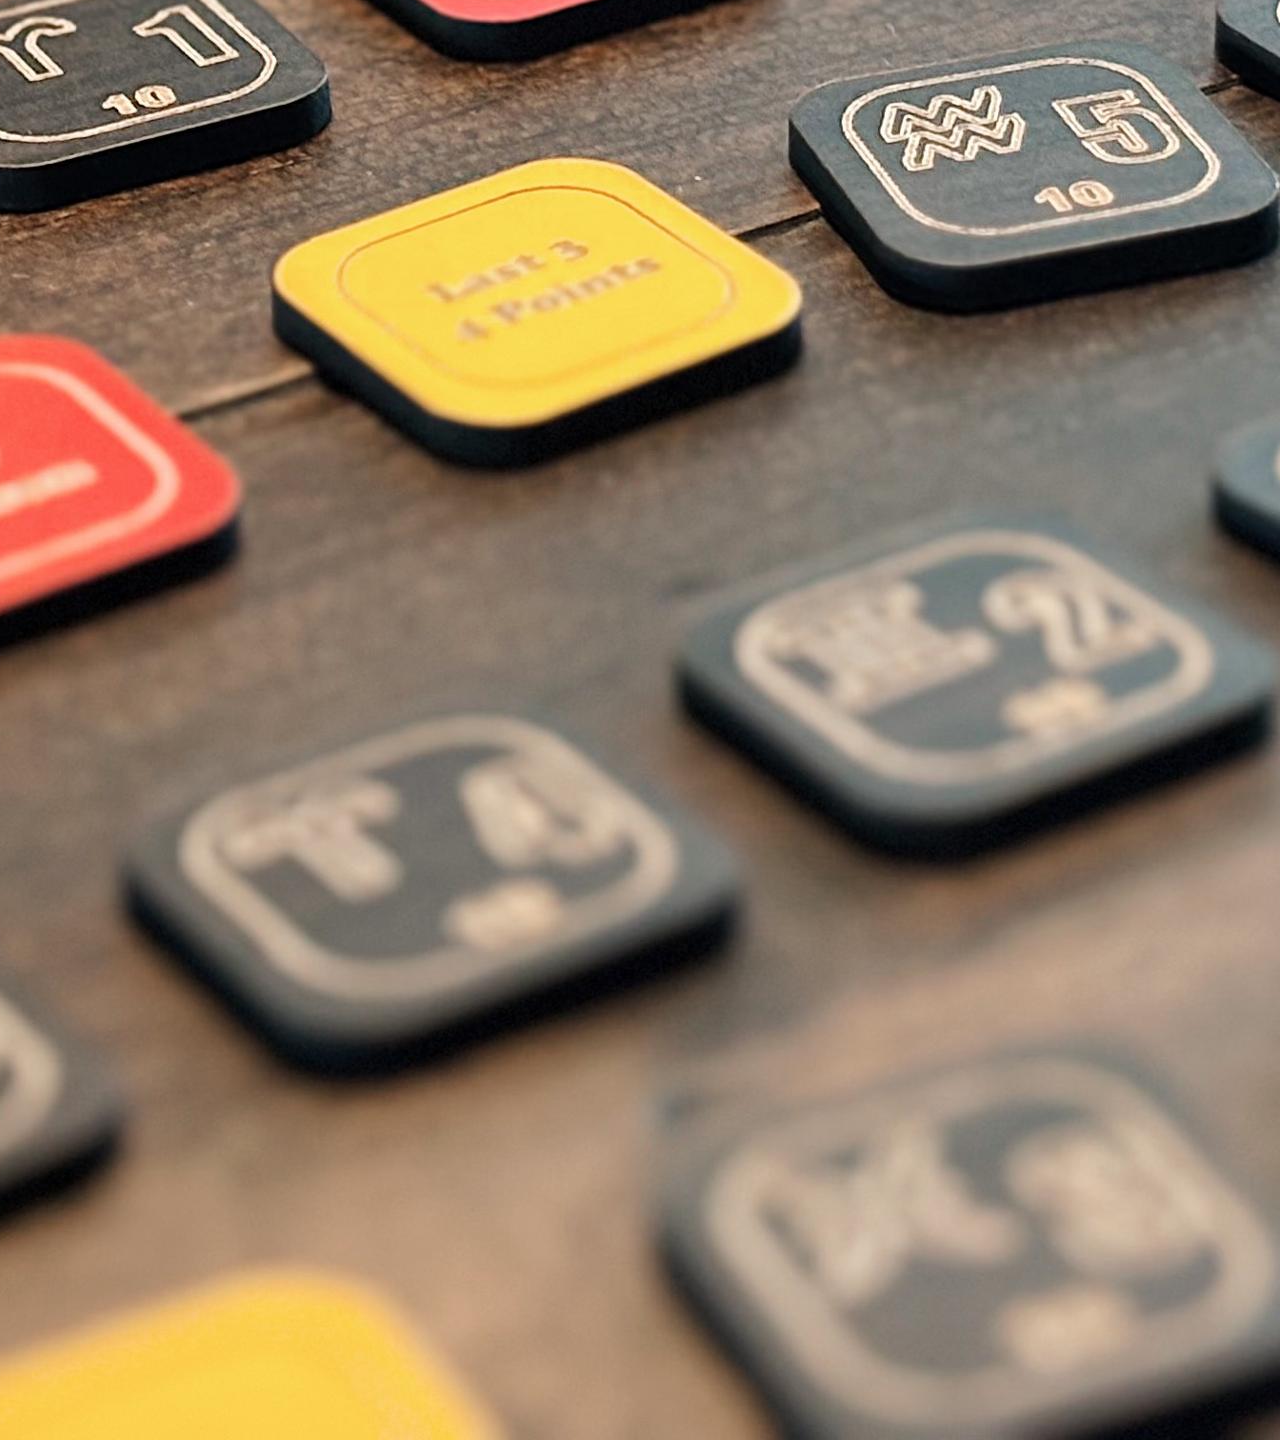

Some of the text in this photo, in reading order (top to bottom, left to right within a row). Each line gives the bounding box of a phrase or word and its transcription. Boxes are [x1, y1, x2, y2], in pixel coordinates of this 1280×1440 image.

[134, 4, 238, 67] 1
[101, 83, 177, 116] 10
[1052, 88, 1181, 164] 5
[1034, 179, 1114, 214] 10
[426, 239, 590, 304] Last 3
[491, 257, 662, 327] Points
[978, 565, 1168, 674] 2
